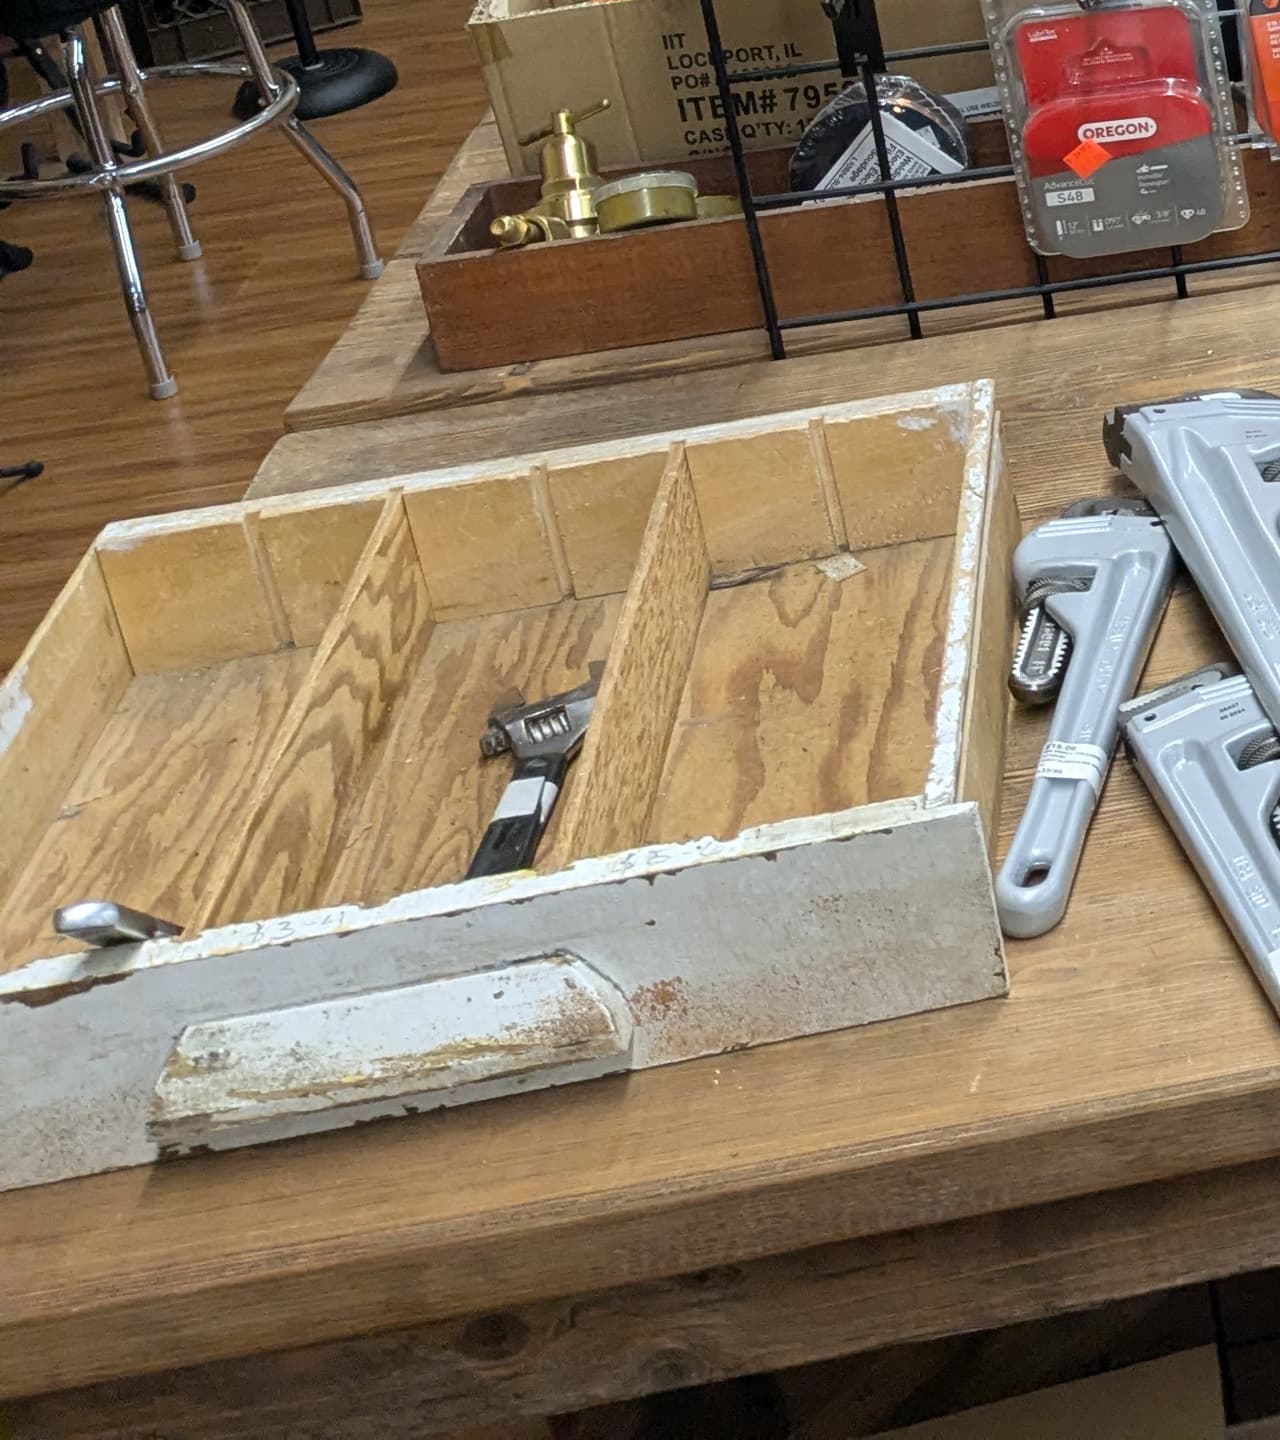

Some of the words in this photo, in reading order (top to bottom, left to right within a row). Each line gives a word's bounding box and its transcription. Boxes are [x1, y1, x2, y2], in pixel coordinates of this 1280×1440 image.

[661, 33, 686, 49] IIT
[783, 42, 802, 57] IL
[671, 73, 711, 90] PO#
[677, 90, 778, 123] ITEM#
[741, 121, 796, 140] Q'TY:
[1081, 121, 1151, 140] OREGON
[1043, 177, 1094, 190] AdvanceCut
[1056, 190, 1084, 204] S48
